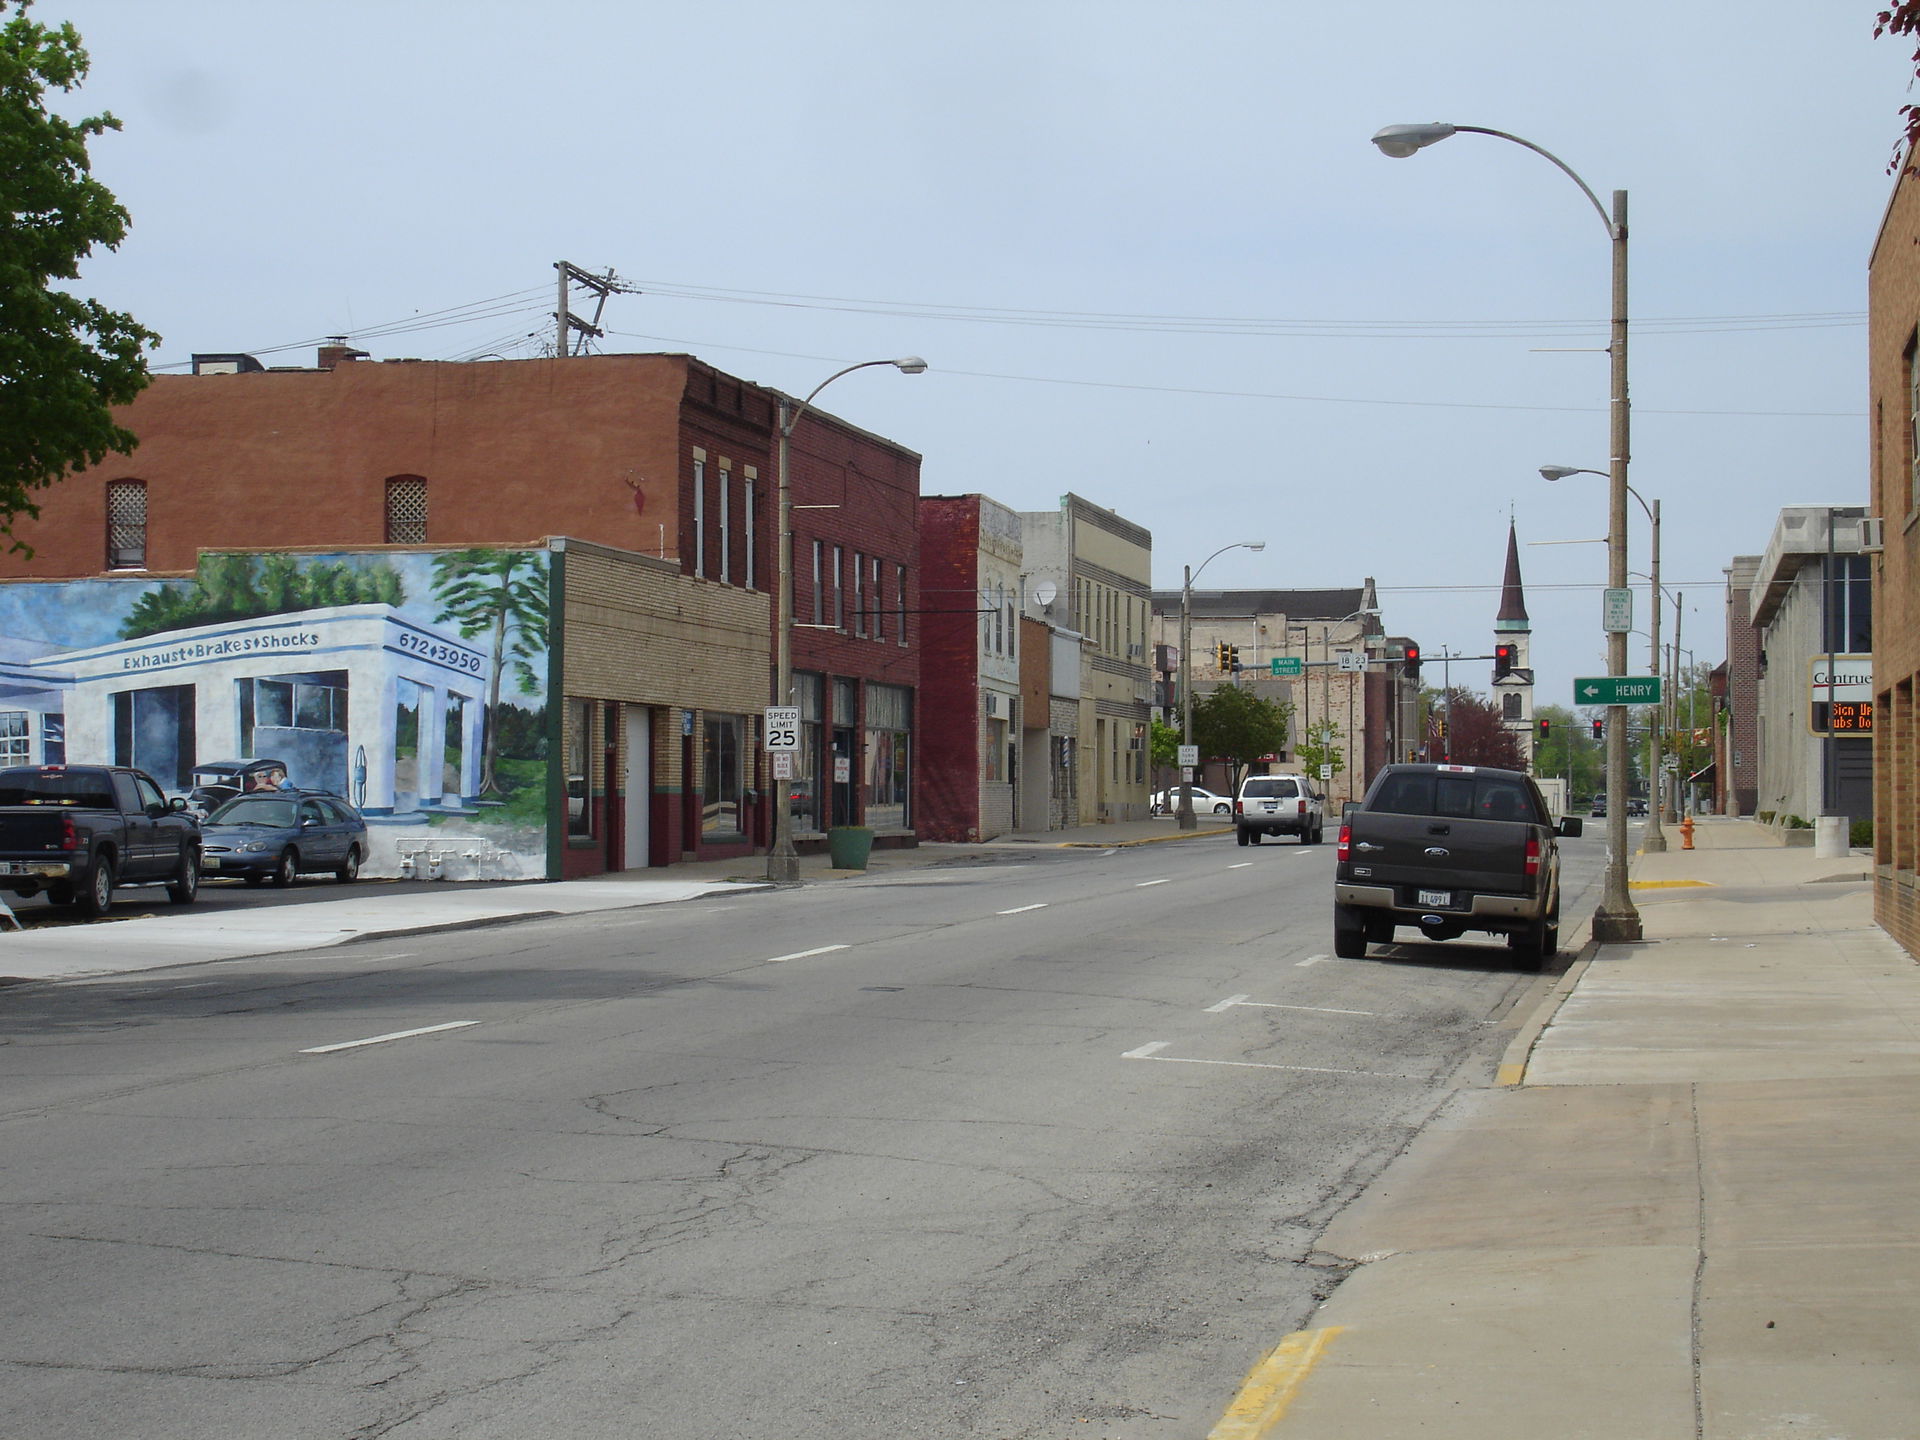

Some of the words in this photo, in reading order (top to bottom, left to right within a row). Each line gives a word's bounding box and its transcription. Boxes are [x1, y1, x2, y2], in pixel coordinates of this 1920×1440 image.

[124, 648, 187, 669] Exhaust
[195, 639, 251, 658] Brakes
[262, 632, 319, 648] Shocks
[1615, 685, 1652, 697] HENRY
[768, 712, 797, 720] SPEED
[770, 721, 794, 729] LIMIT
[1828, 716, 1853, 729] ubs
[769, 730, 796, 746] 25
